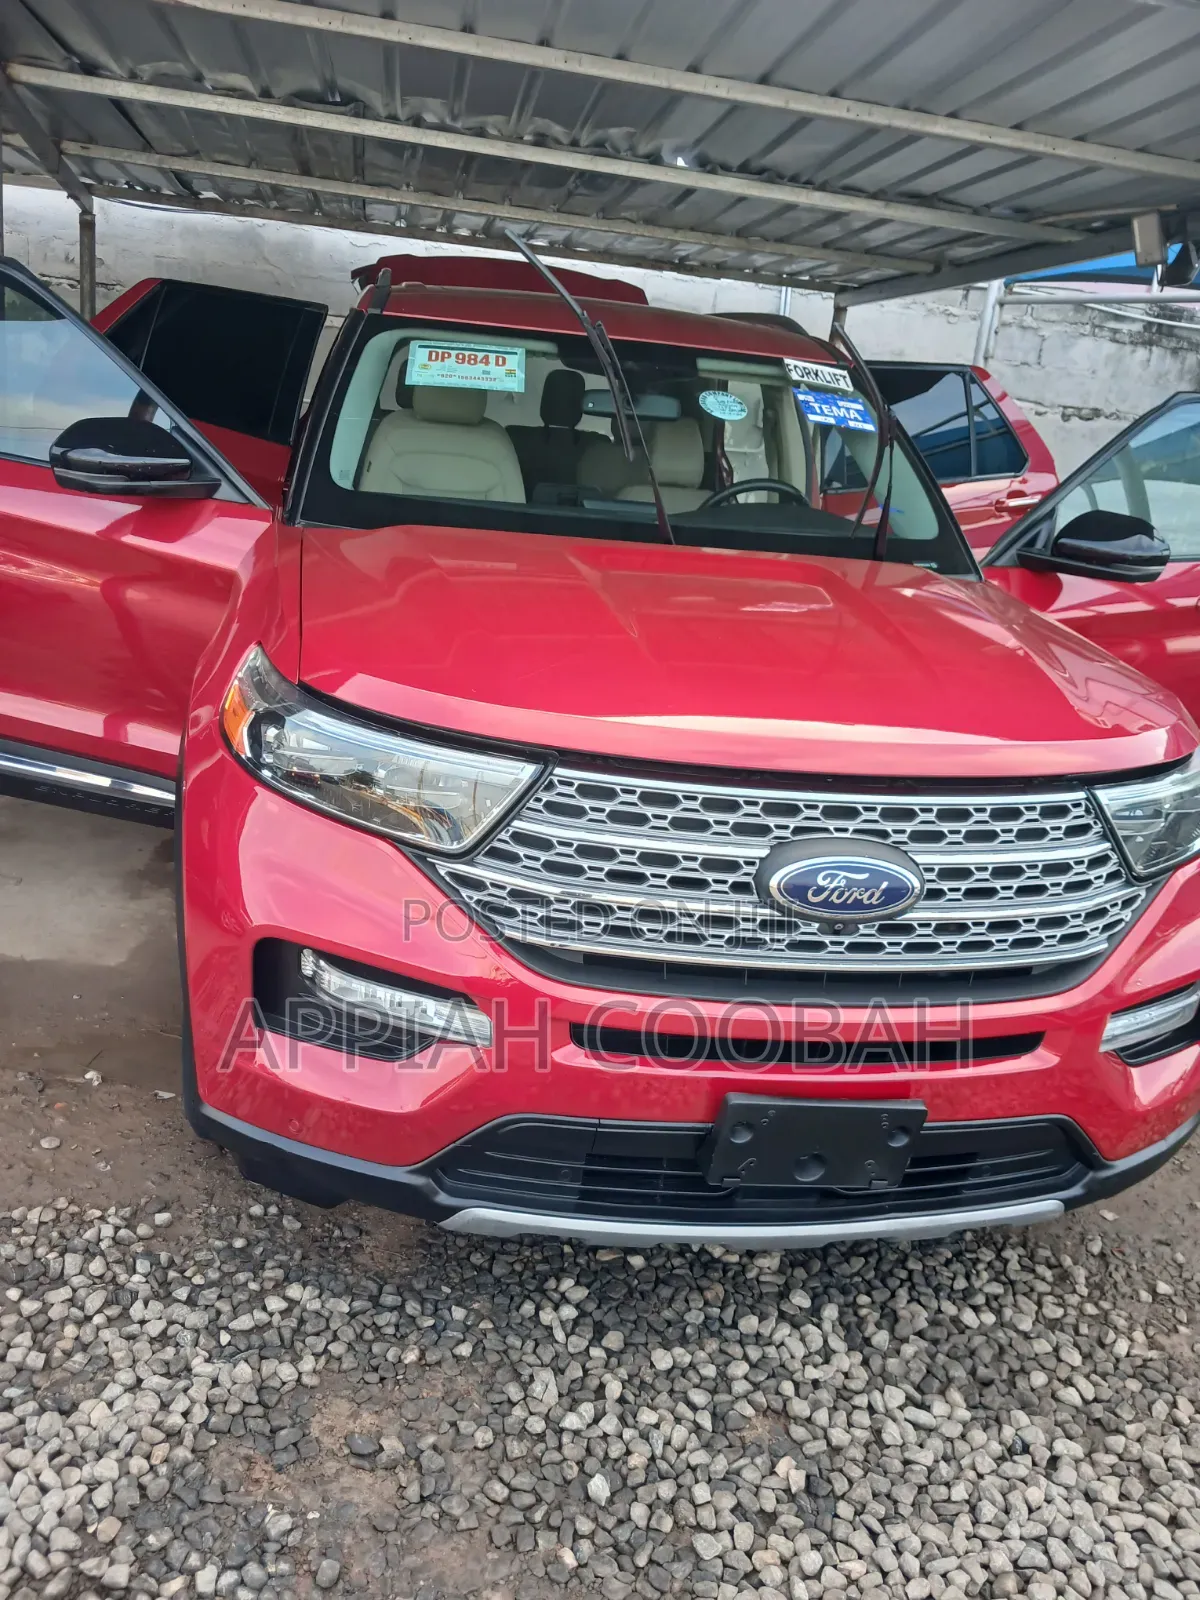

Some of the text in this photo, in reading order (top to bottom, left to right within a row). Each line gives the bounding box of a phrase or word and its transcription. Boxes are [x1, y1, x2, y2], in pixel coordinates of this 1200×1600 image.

[428, 350, 507, 367] DP 984 D
[786, 362, 851, 389] FORKLIFT
[809, 402, 863, 421] TEMA
[807, 869, 889, 905] Ford
